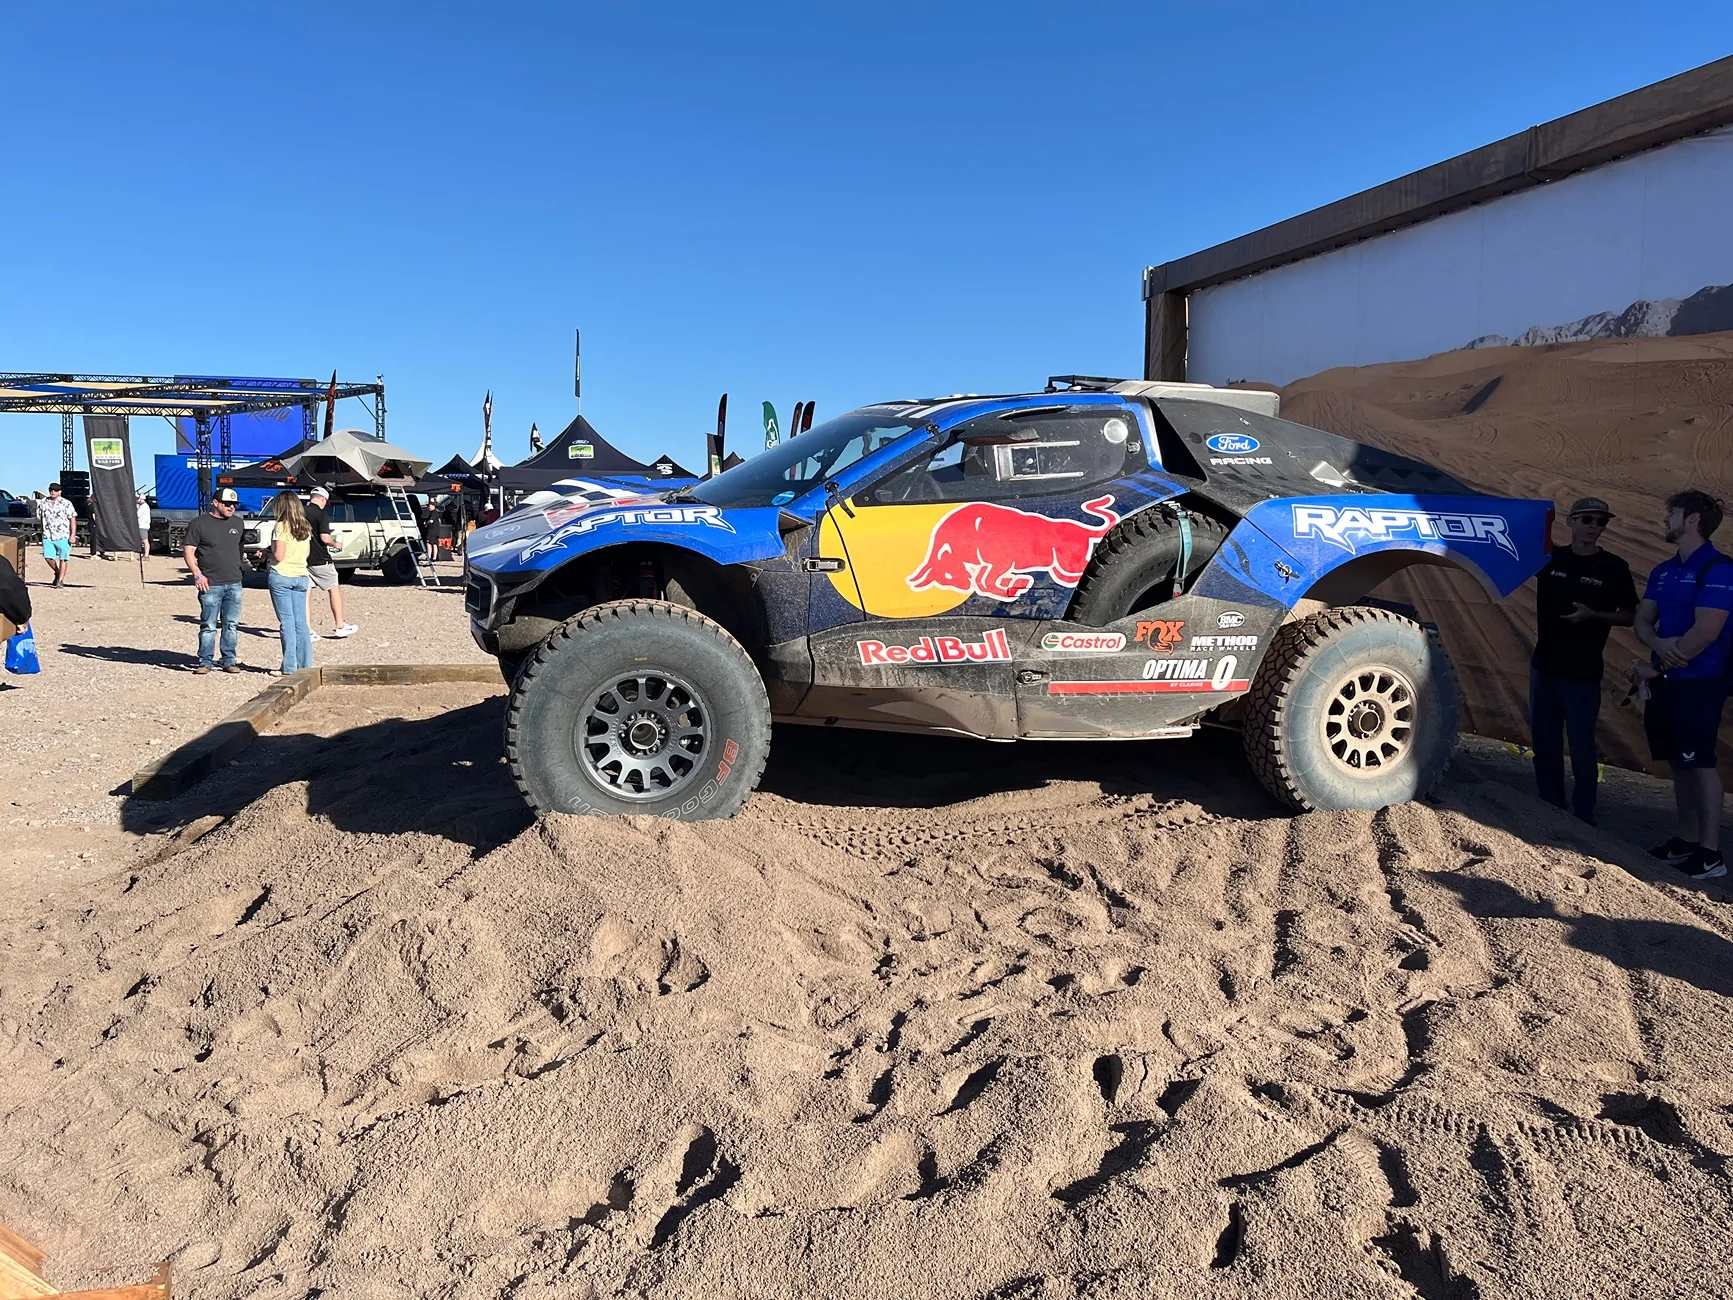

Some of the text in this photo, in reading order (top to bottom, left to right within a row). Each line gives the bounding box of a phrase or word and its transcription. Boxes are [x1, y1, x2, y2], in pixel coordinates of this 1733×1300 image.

[1217, 436, 1251, 450] Ford
[1209, 457, 1273, 466] RACING
[519, 507, 737, 565] RAPTOR
[1291, 504, 1520, 562] RAPTOR
[857, 628, 1013, 666] Red Bull
[1061, 634, 1123, 650] Castrol
[1134, 620, 1185, 654] FOX
[1190, 635, 1258, 646] METHOD
[1142, 659, 1208, 680] OPTIMA
